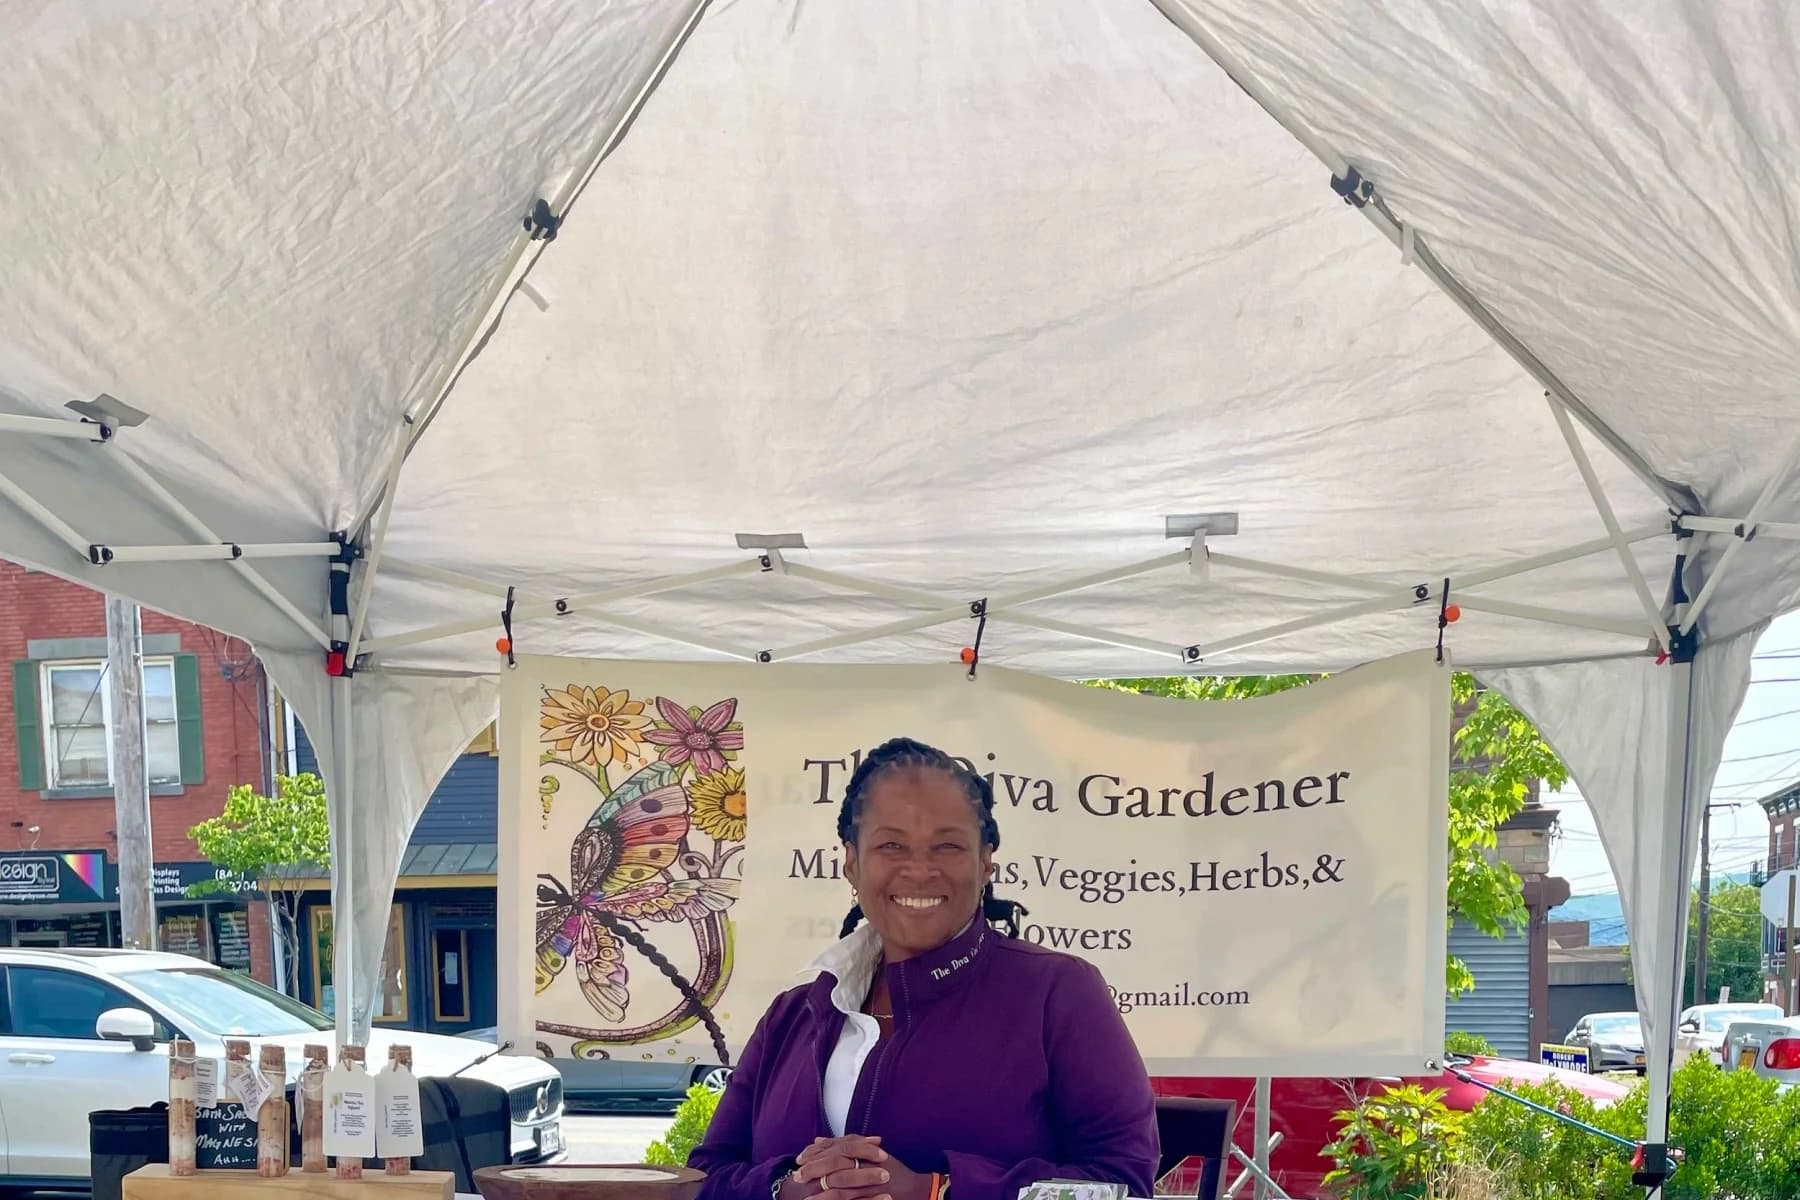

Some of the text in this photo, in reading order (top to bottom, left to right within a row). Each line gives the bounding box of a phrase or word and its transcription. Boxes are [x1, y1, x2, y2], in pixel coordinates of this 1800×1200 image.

[950, 752, 1350, 818] iva Gardener
[0, 863, 47, 885] esign
[930, 967, 951, 980] The
